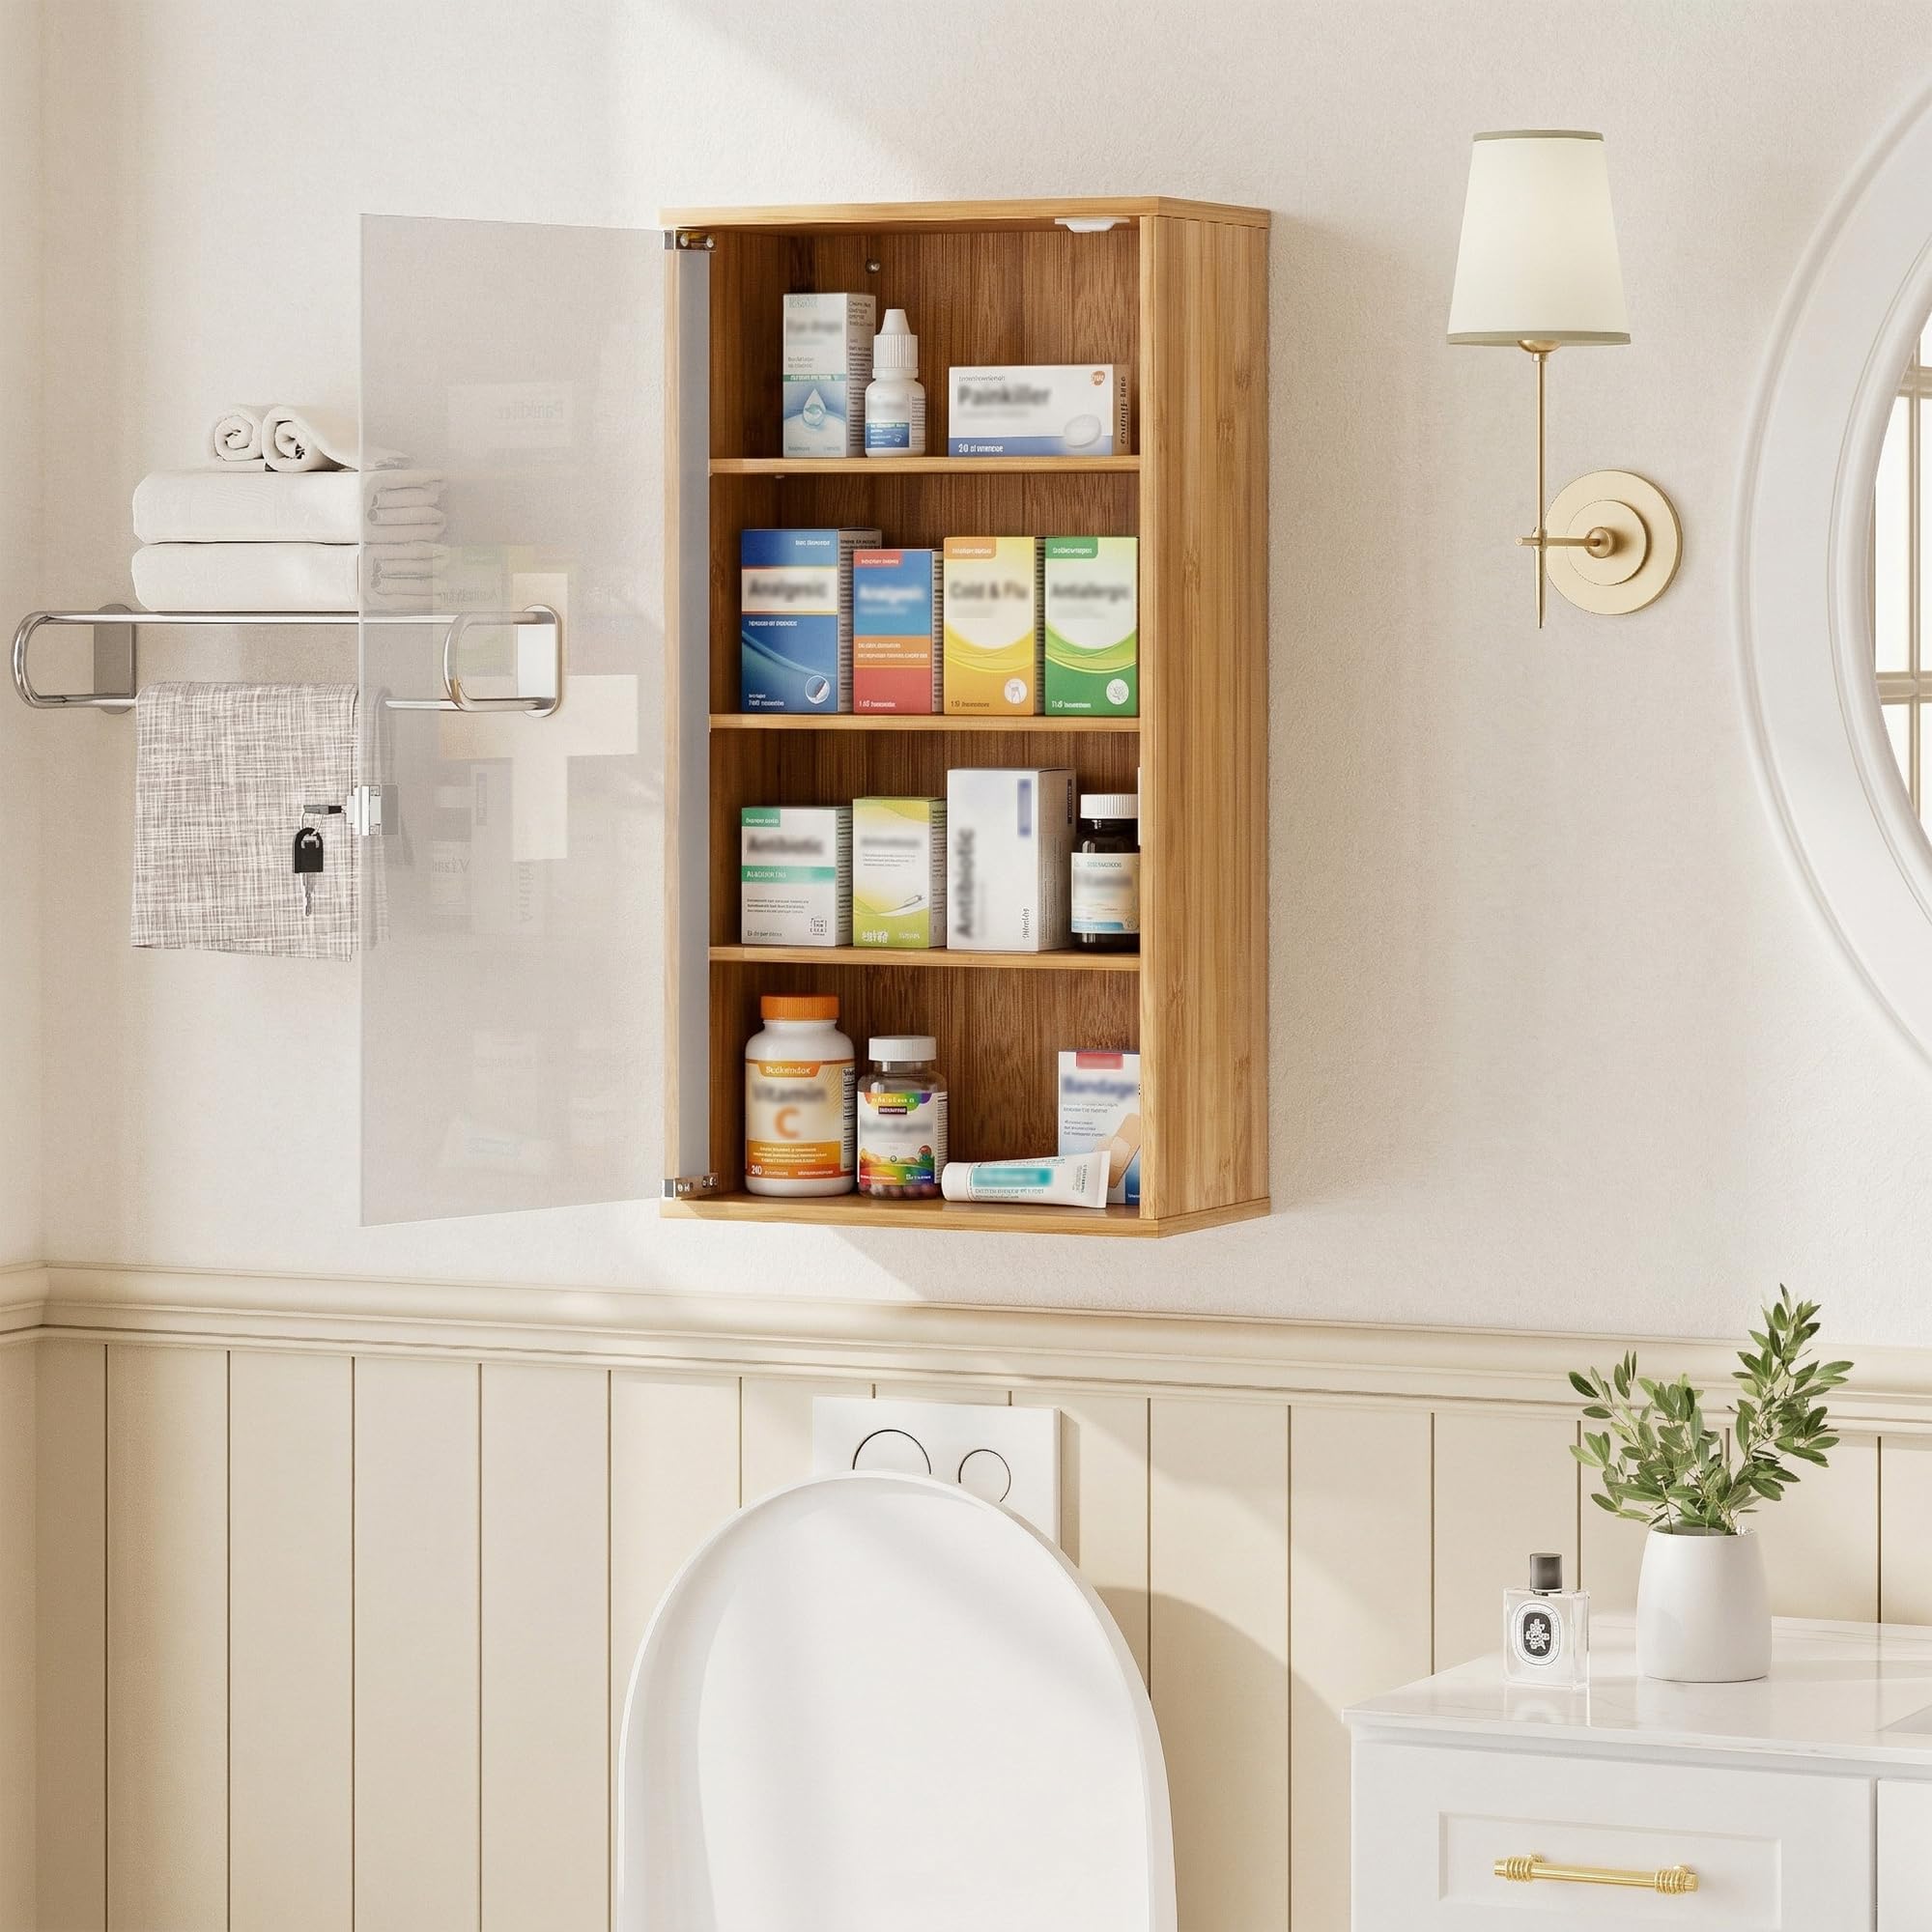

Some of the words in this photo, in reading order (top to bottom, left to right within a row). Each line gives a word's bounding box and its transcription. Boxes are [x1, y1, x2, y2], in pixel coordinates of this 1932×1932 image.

[959, 385, 1050, 404] Painkiller
[951, 582, 984, 598] Cold
[1004, 582, 1028, 598] Flu
[775, 1107, 800, 1139] C
